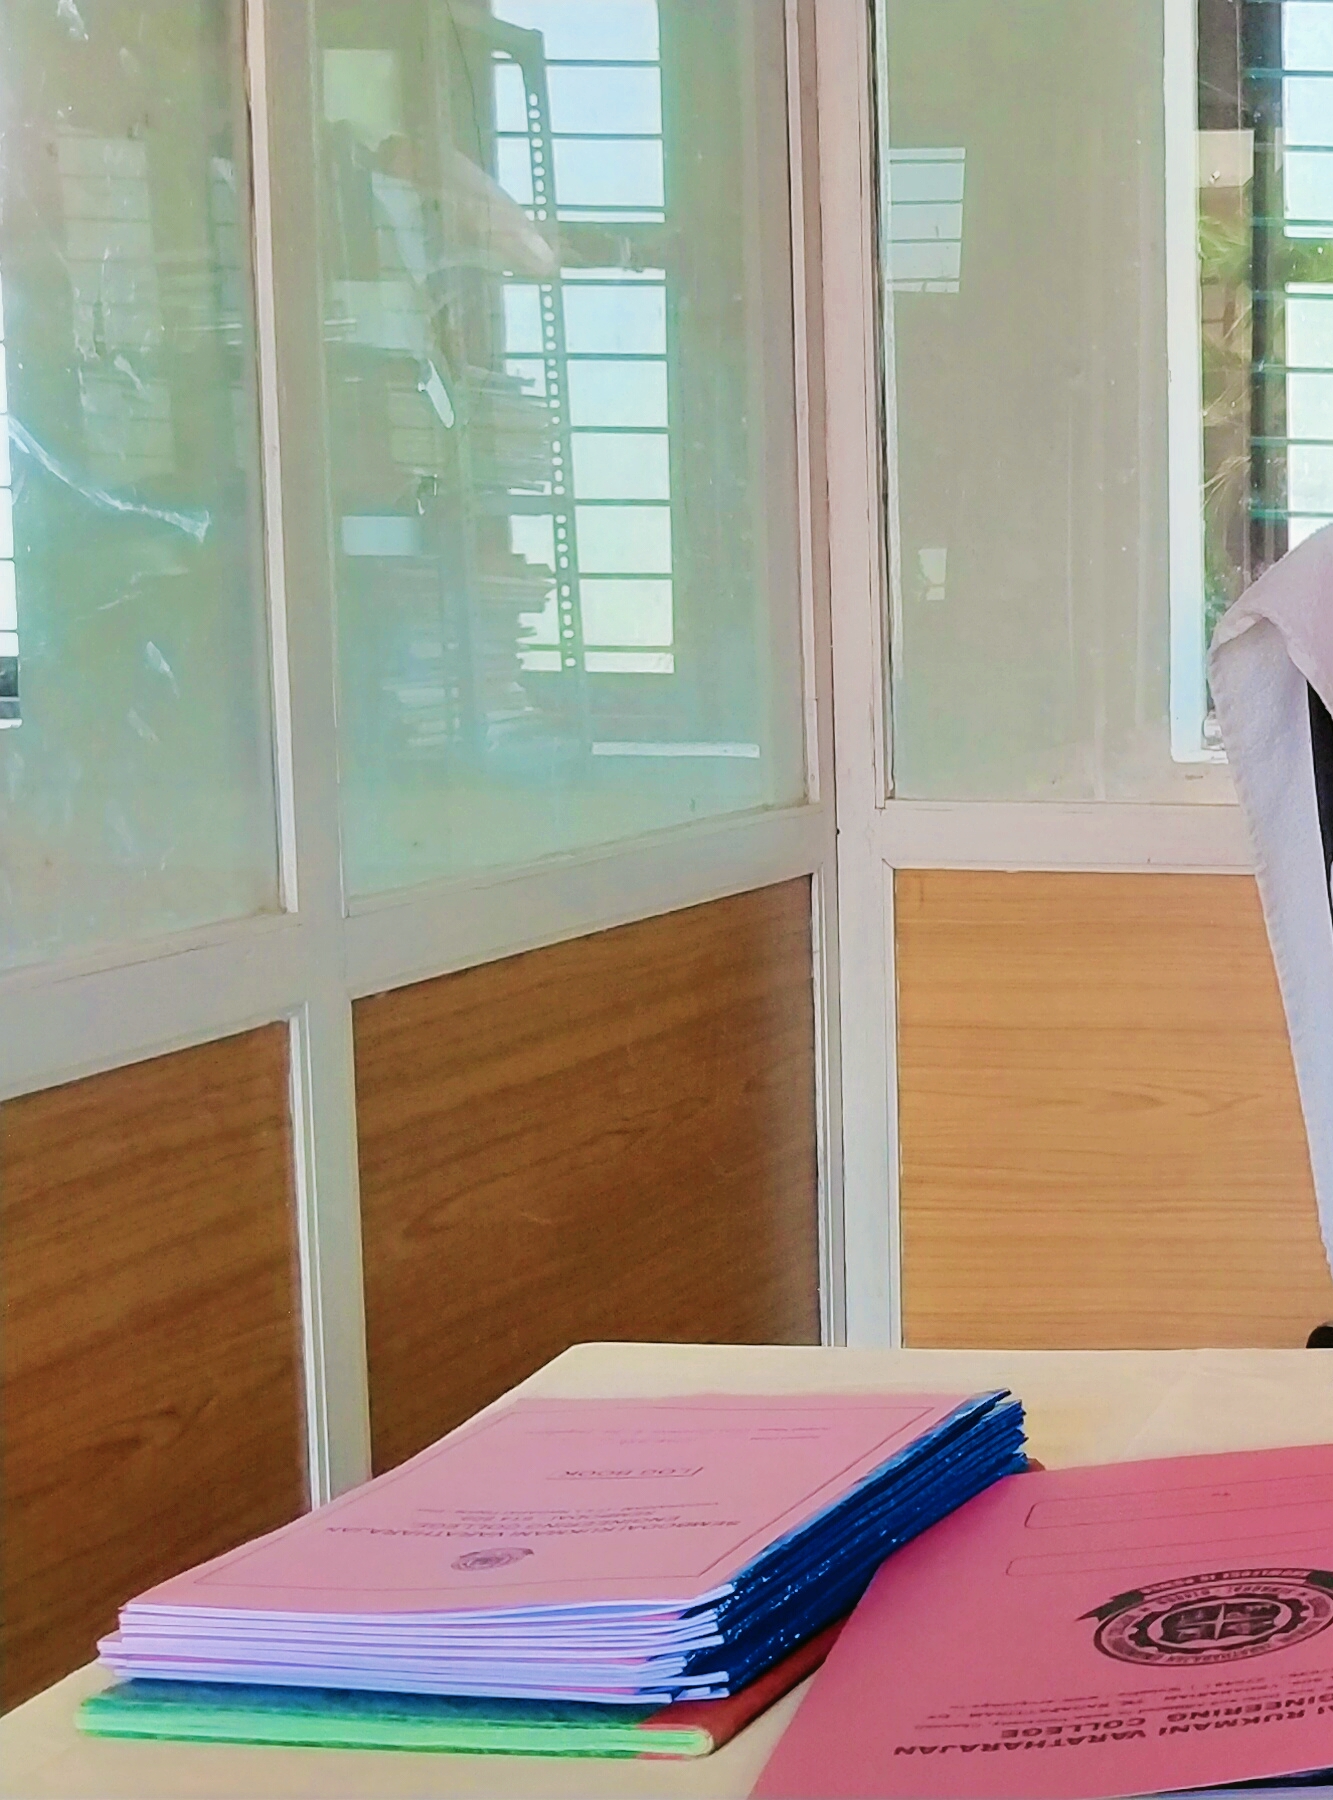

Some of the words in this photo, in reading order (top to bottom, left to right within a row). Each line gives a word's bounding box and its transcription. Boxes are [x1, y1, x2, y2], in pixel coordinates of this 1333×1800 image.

[1002, 1717, 1146, 1739] COLLEGE
[1159, 1709, 1305, 1736] RUKMANI
[894, 1730, 1146, 1756] VARATHARAJAN
